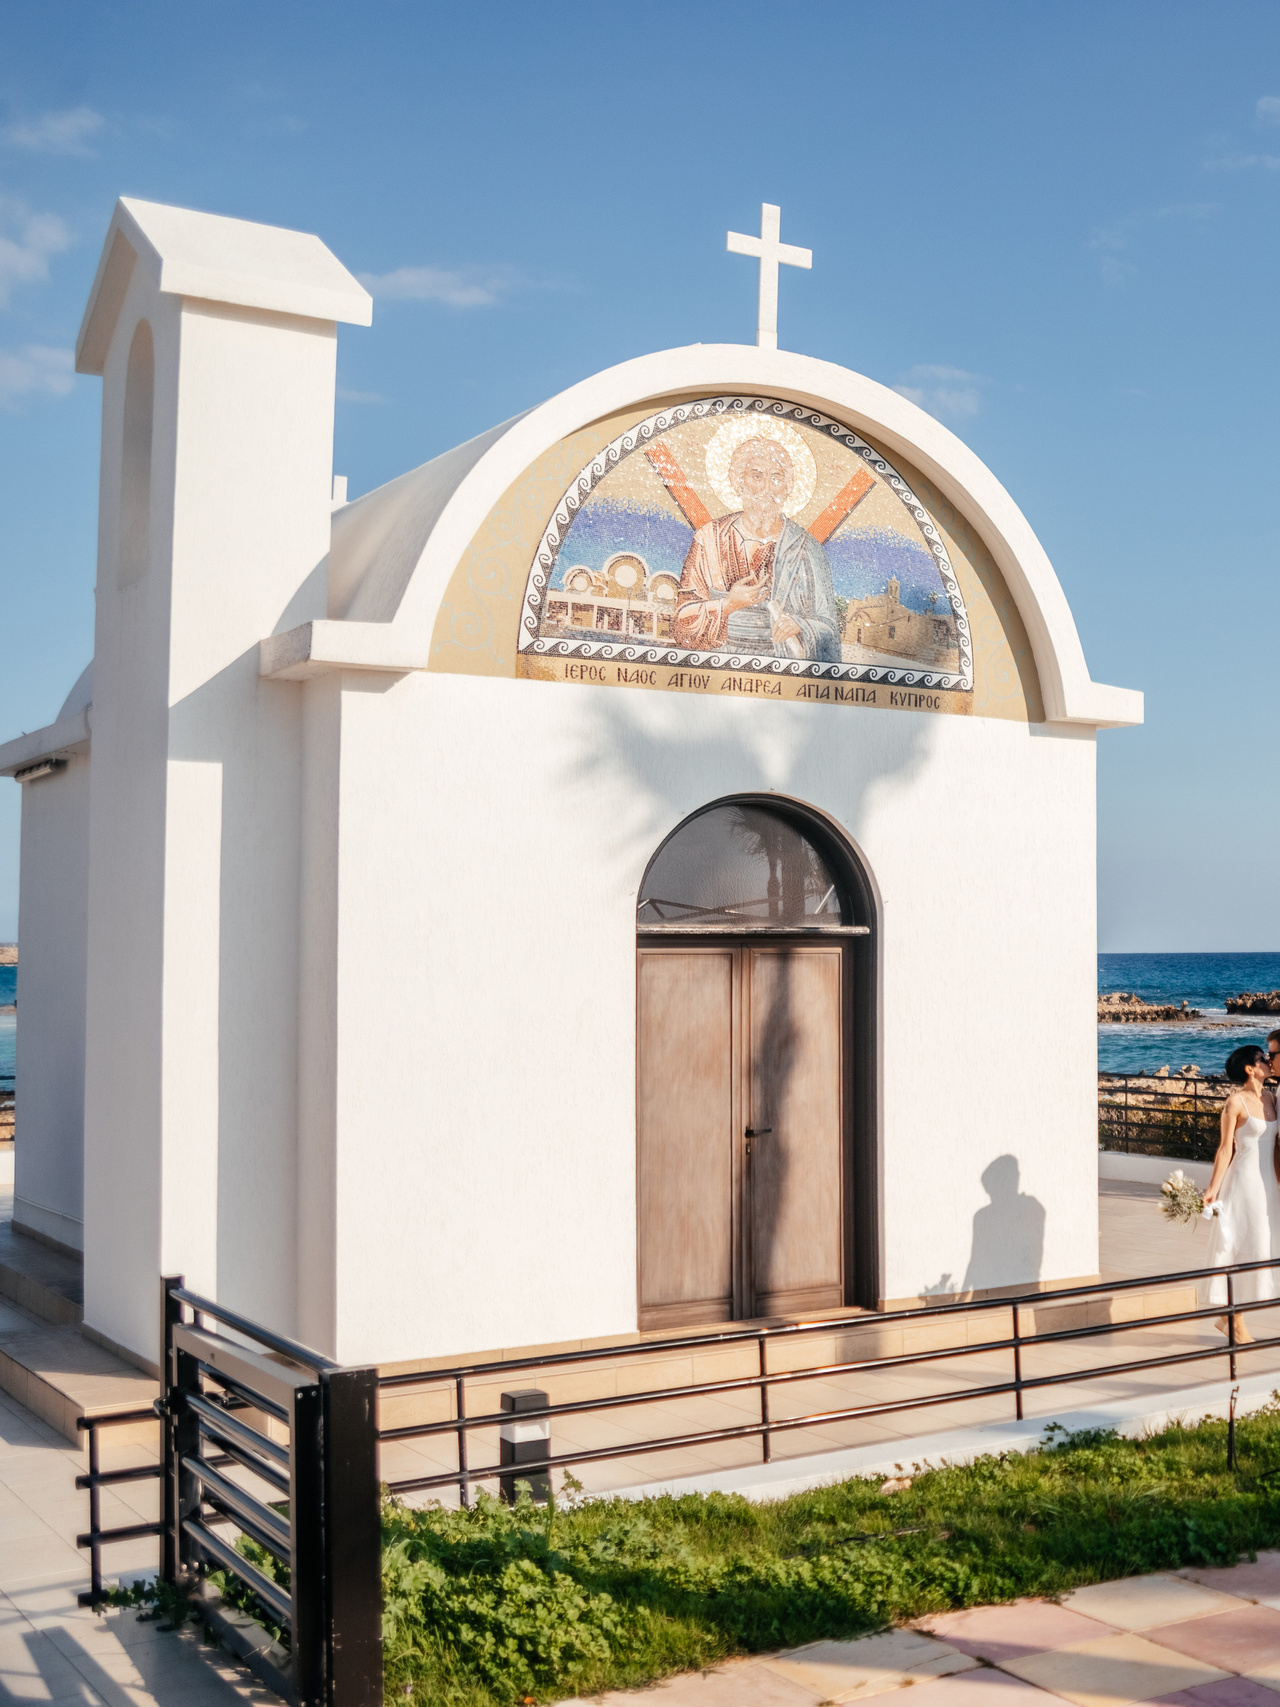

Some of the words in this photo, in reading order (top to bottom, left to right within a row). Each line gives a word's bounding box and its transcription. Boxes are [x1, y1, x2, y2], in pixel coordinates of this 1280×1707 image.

[667, 673, 711, 690] ΑΓΙΟΥ
[796, 683, 830, 700] ΑΓΙΑ
[834, 686, 877, 704] ΝΑΠΑ
